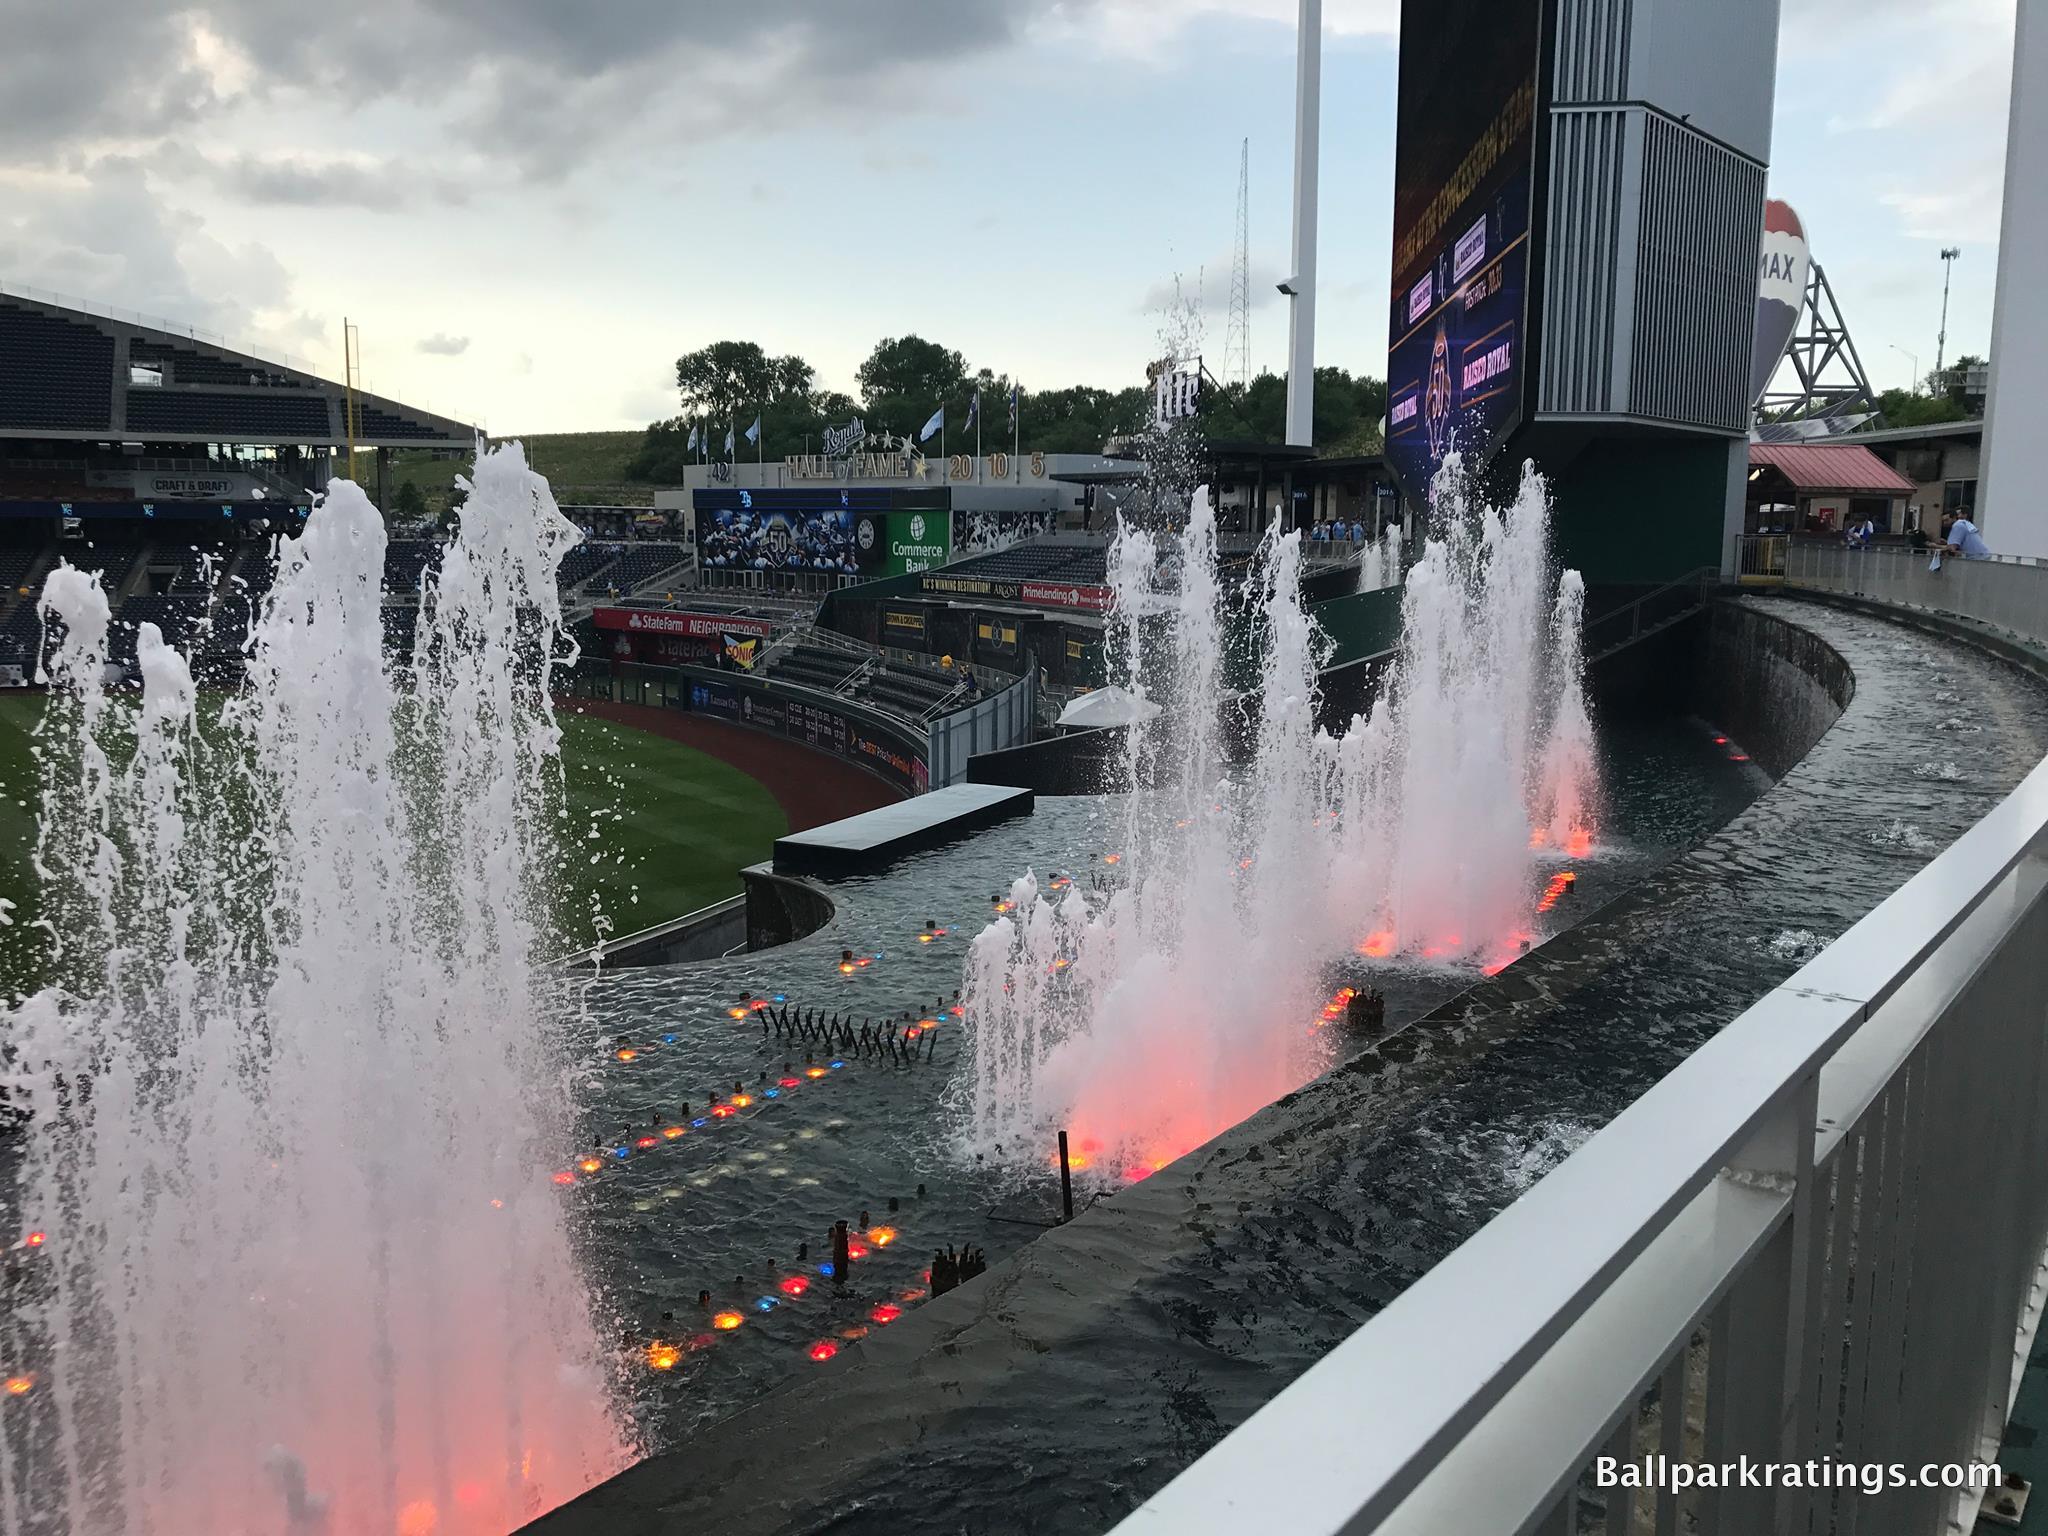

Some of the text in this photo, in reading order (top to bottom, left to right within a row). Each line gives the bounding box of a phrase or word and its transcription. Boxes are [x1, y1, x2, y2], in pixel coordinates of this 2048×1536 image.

[1463, 341, 1511, 390] RAISED ROYAL
[822, 415, 866, 456] Royals
[711, 462, 729, 482] 42
[785, 453, 909, 481] HALL of FAME
[949, 454, 972, 480] 20
[988, 452, 1008, 479] 10
[1031, 451, 1045, 478] 5
[155, 480, 228, 491] CRAFT & DRAFT
[769, 531, 787, 553] 50
[892, 541, 943, 557] Commerce
[906, 558, 929, 573] Bank
[935, 578, 956, 592] WINNING
[957, 580, 991, 594] DESTINATION!
[993, 584, 1019, 599] ARGOSY
[1023, 586, 1067, 604] PrimeLending
[725, 644, 755, 660] SONIC
